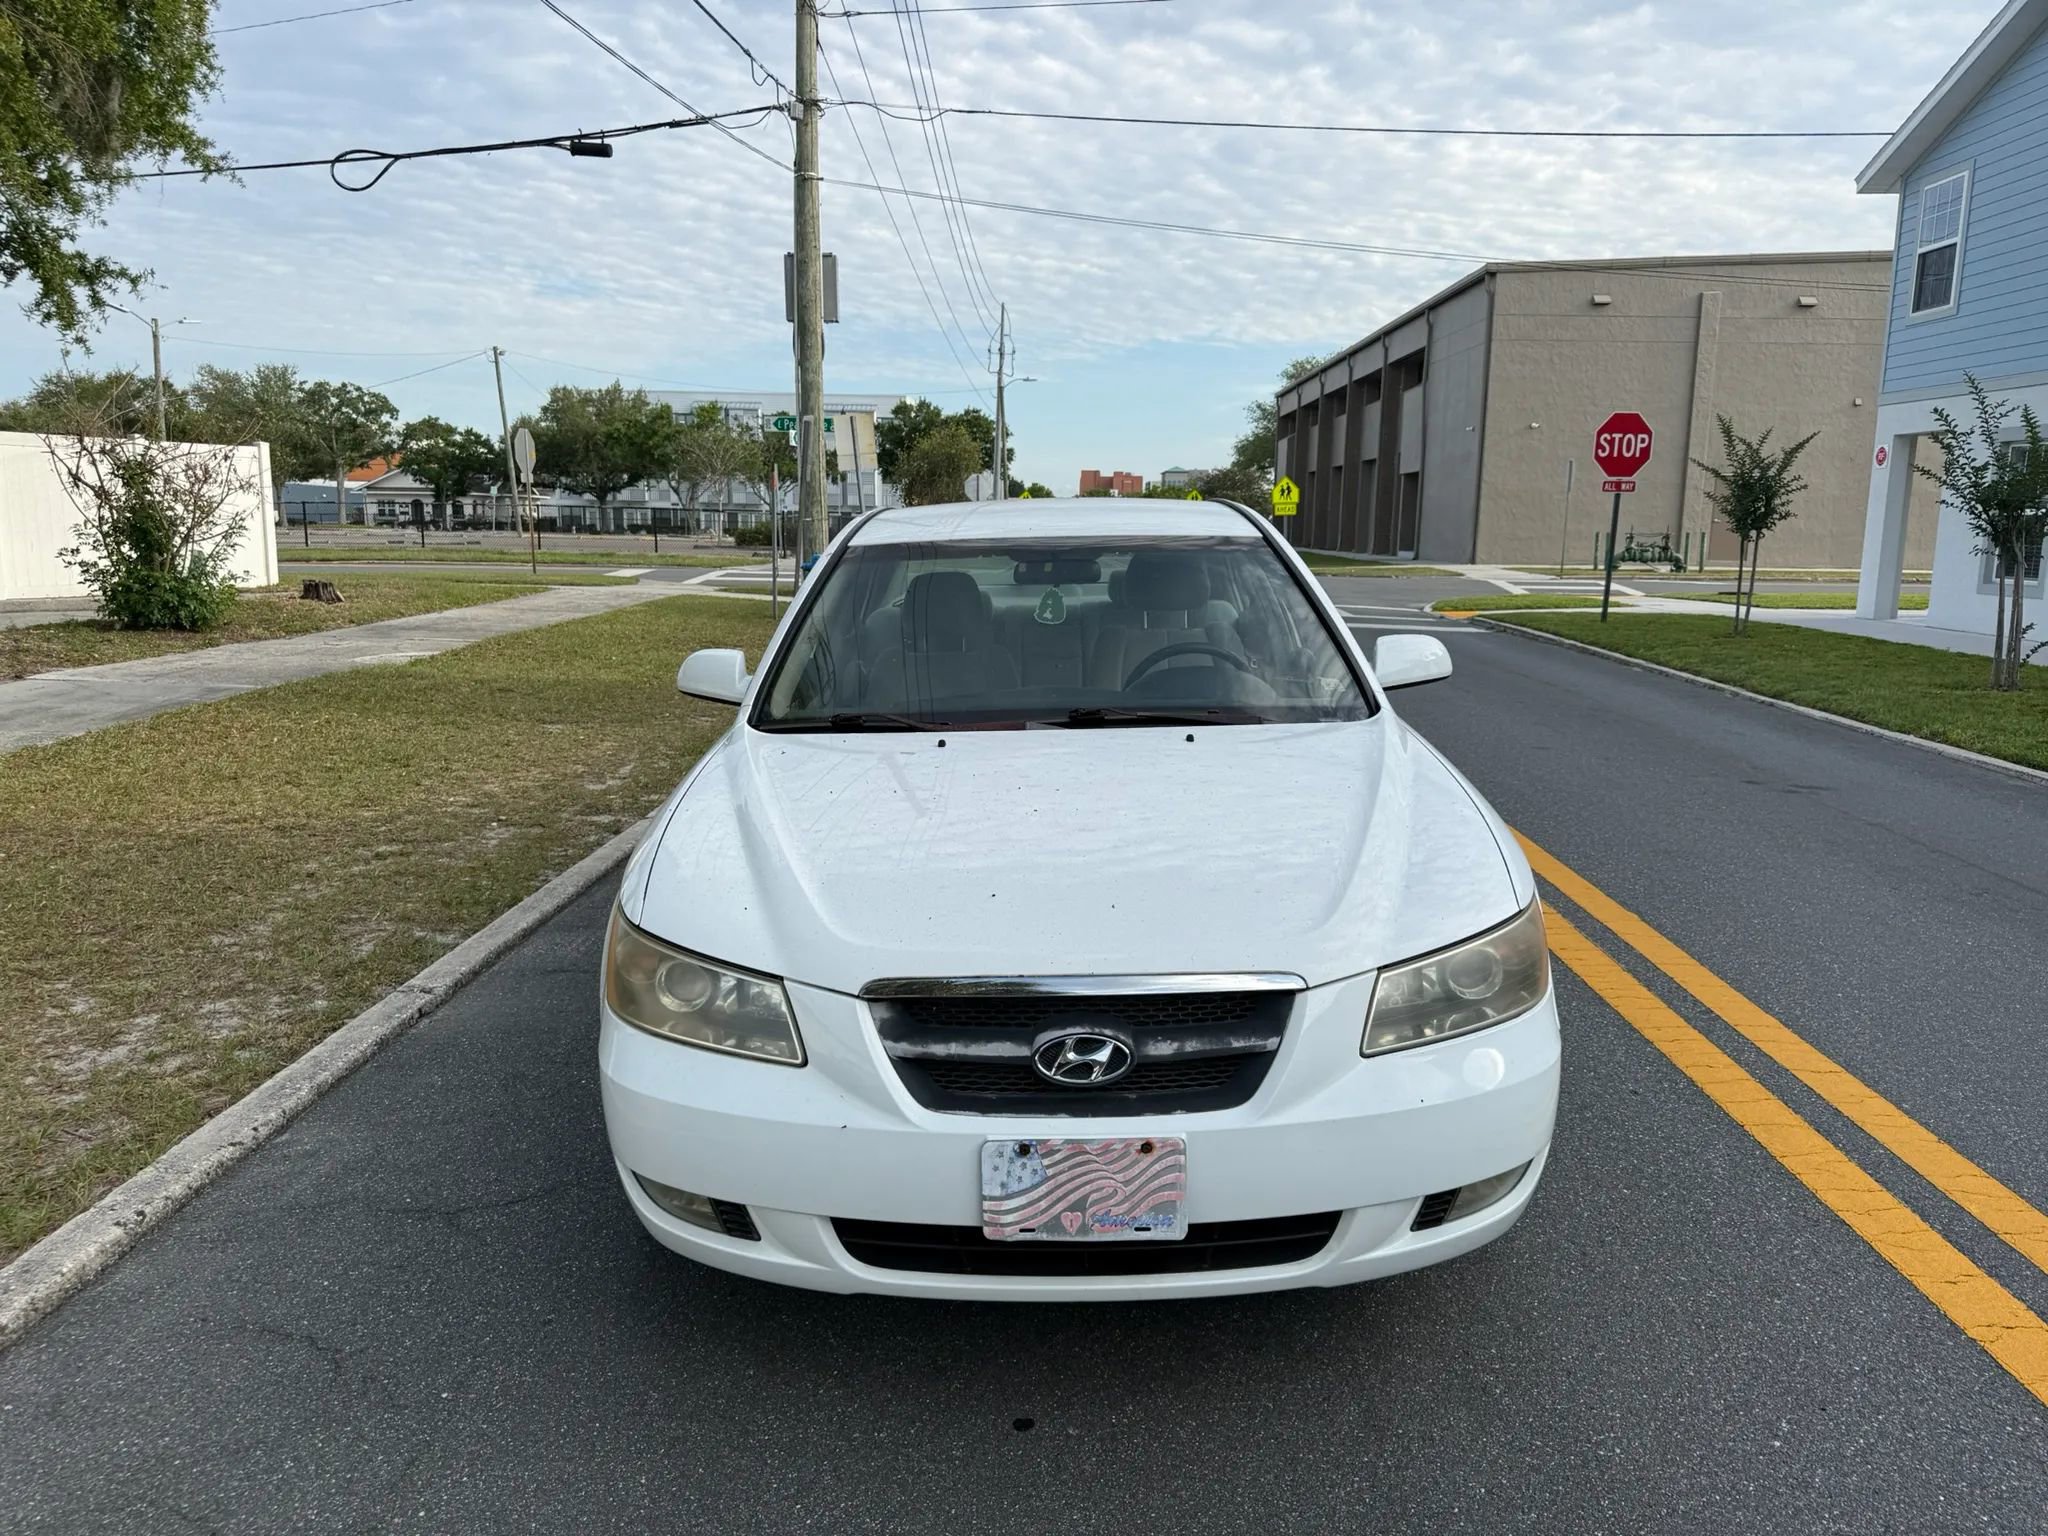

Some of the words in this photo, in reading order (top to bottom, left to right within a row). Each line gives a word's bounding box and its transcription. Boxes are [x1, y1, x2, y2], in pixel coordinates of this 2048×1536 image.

[1597, 433, 1649, 458] STOP
[1604, 483, 1616, 491] ALL
[1620, 483, 1634, 491] WAY
